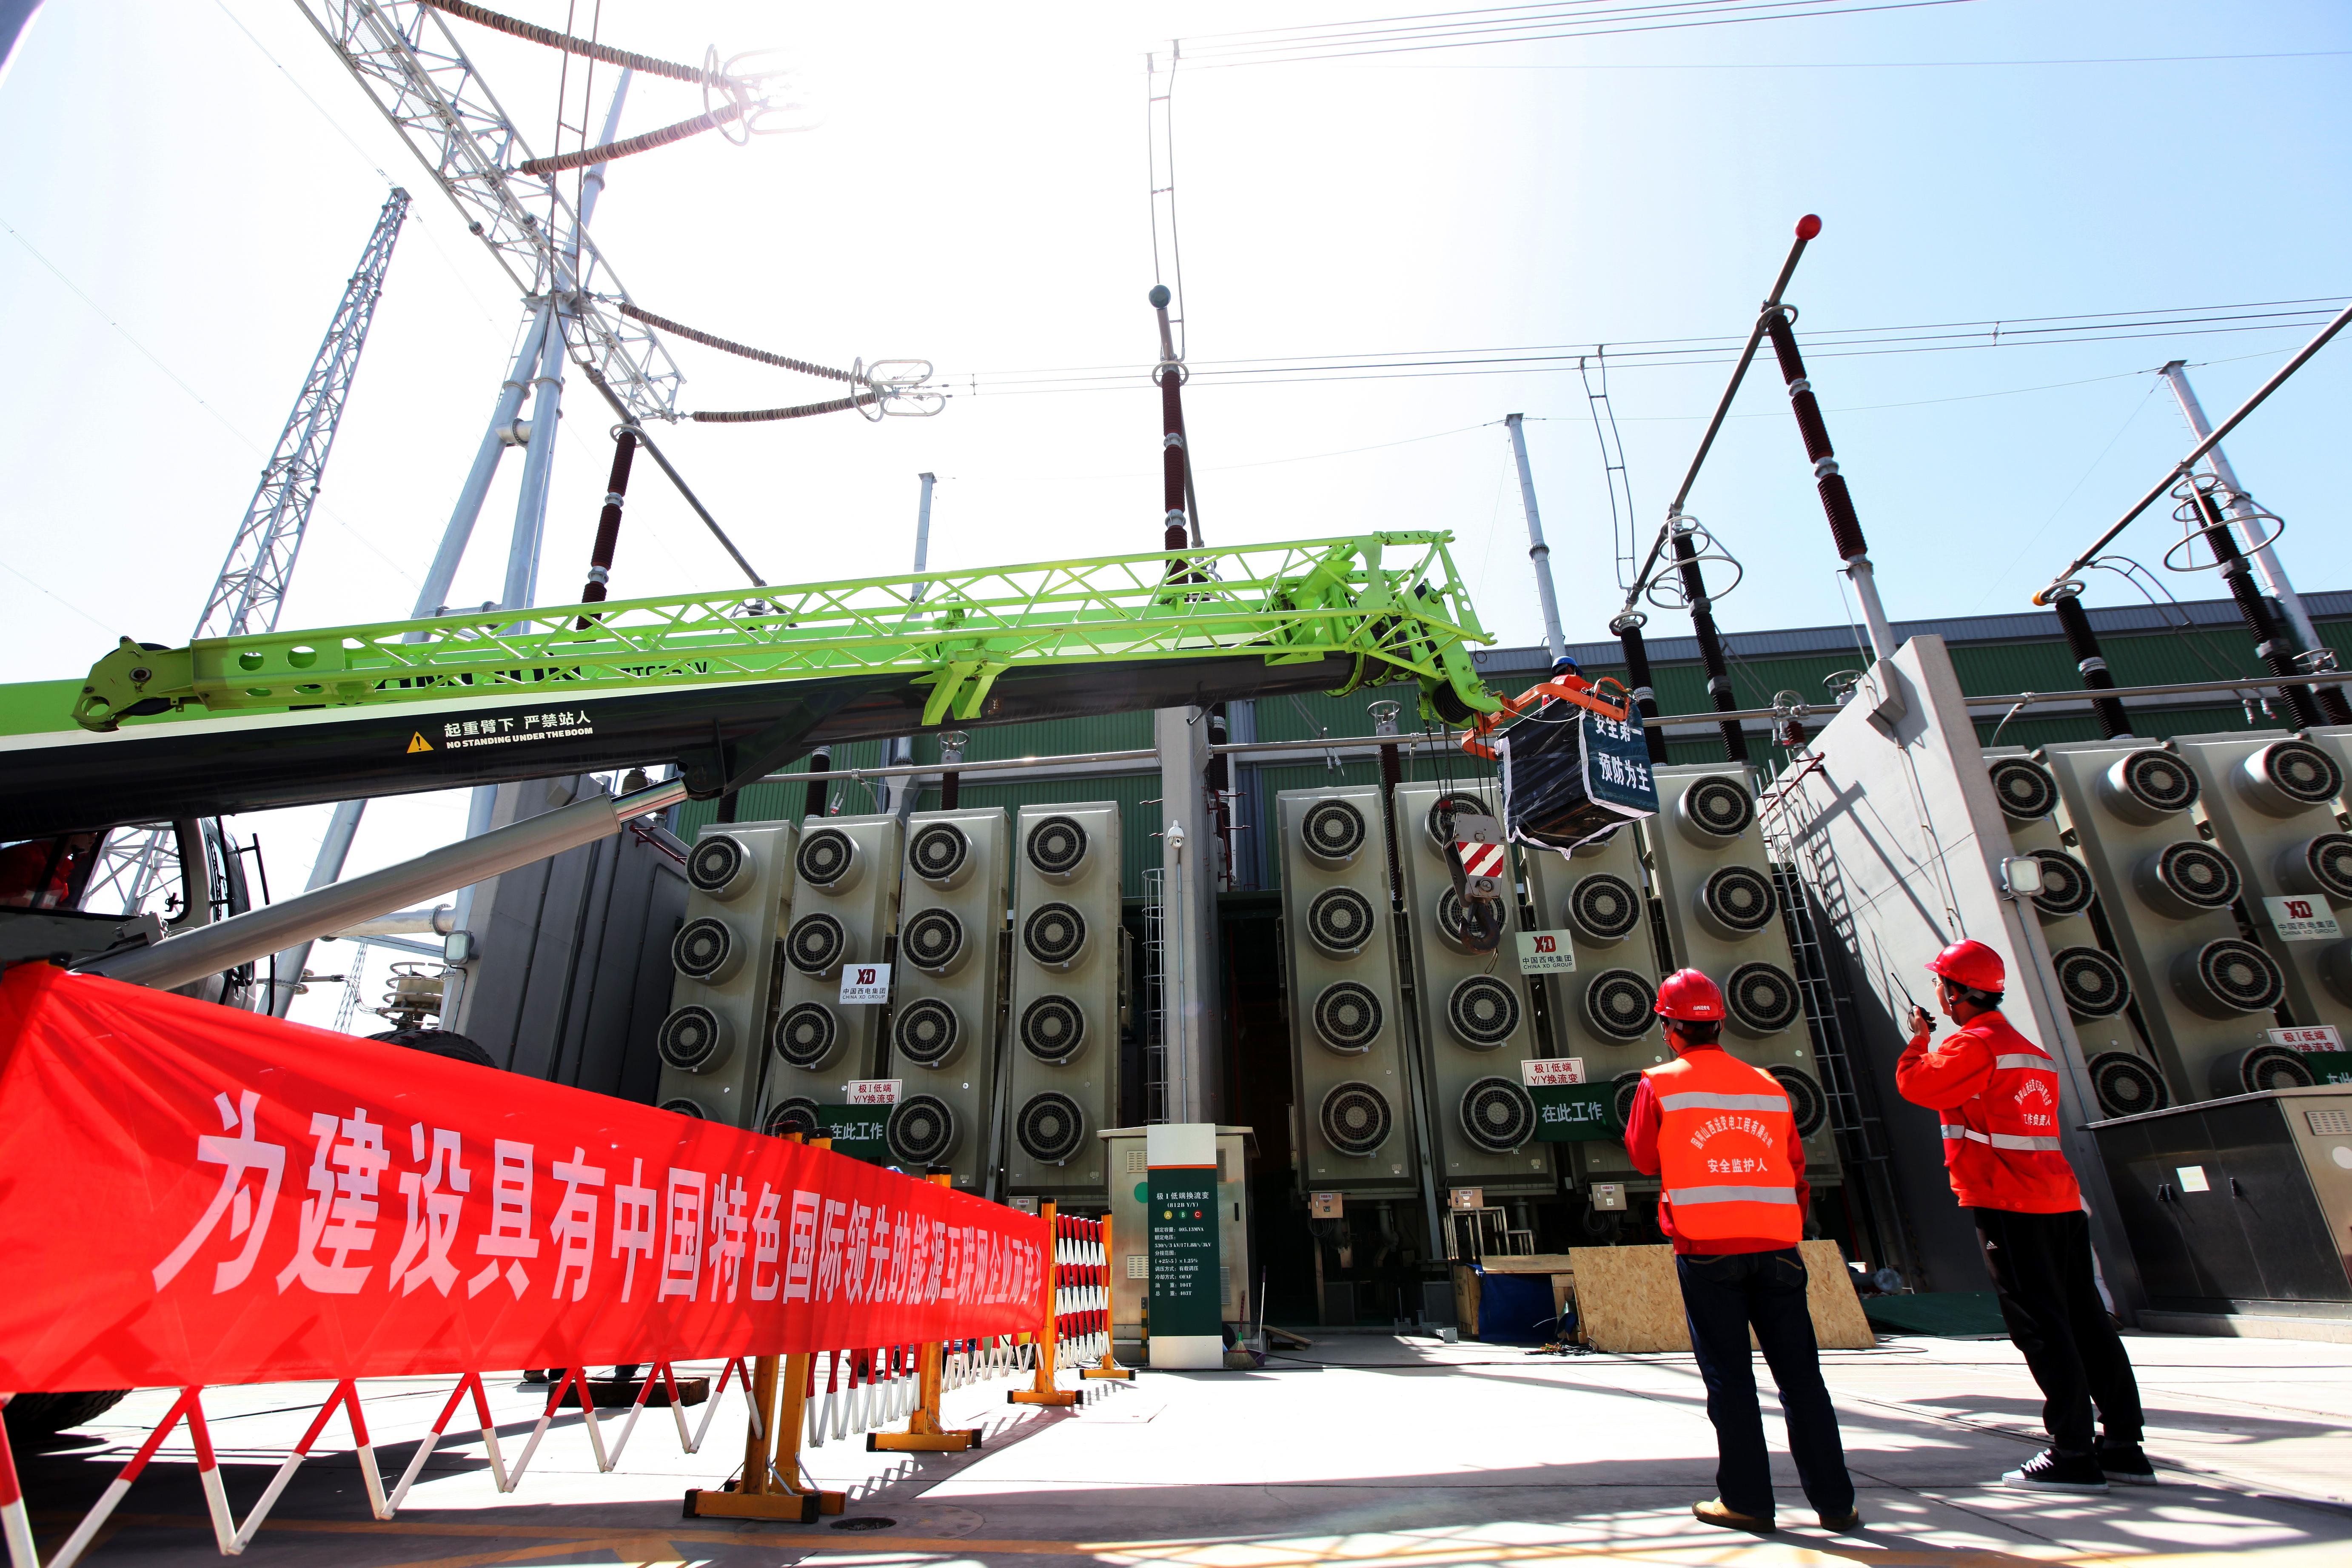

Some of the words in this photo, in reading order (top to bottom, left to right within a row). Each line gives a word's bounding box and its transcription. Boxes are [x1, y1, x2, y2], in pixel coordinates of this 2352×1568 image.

[444, 718, 514, 738] 起重臂下
[524, 710, 591, 730] 严禁站人
[1593, 712, 1642, 742] 安全第一
[447, 741, 461, 749] NO
[462, 736, 511, 747] STANDING
[512, 733, 545, 742] UNDER
[546, 730, 564, 738] THE
[565, 727, 593, 736] BOOM
[1598, 752, 1650, 792] 预防为主
[2278, 920, 2336, 930] 中国西电集团
[1533, 935, 1557, 953] XD
[1522, 955, 1572, 964] 中国西电集团
[856, 969, 876, 985] XD
[1531, 1073, 1579, 1085] Y/Y换流变
[853, 1094, 895, 1103] Y/Y换流变
[1542, 1101, 1603, 1123] 在此工作
[2023, 1113, 2051, 1126] 工作负责人
[830, 1122, 884, 1140] 在此工作
[1691, 1115, 1773, 1150] 国网山西送变电工程有限公司
[1707, 1158, 1768, 1173] 安全监护人
[151, 1089, 1042, 1306] 为建设具有中国特色国际领先的能源互联网企业而奋斗
